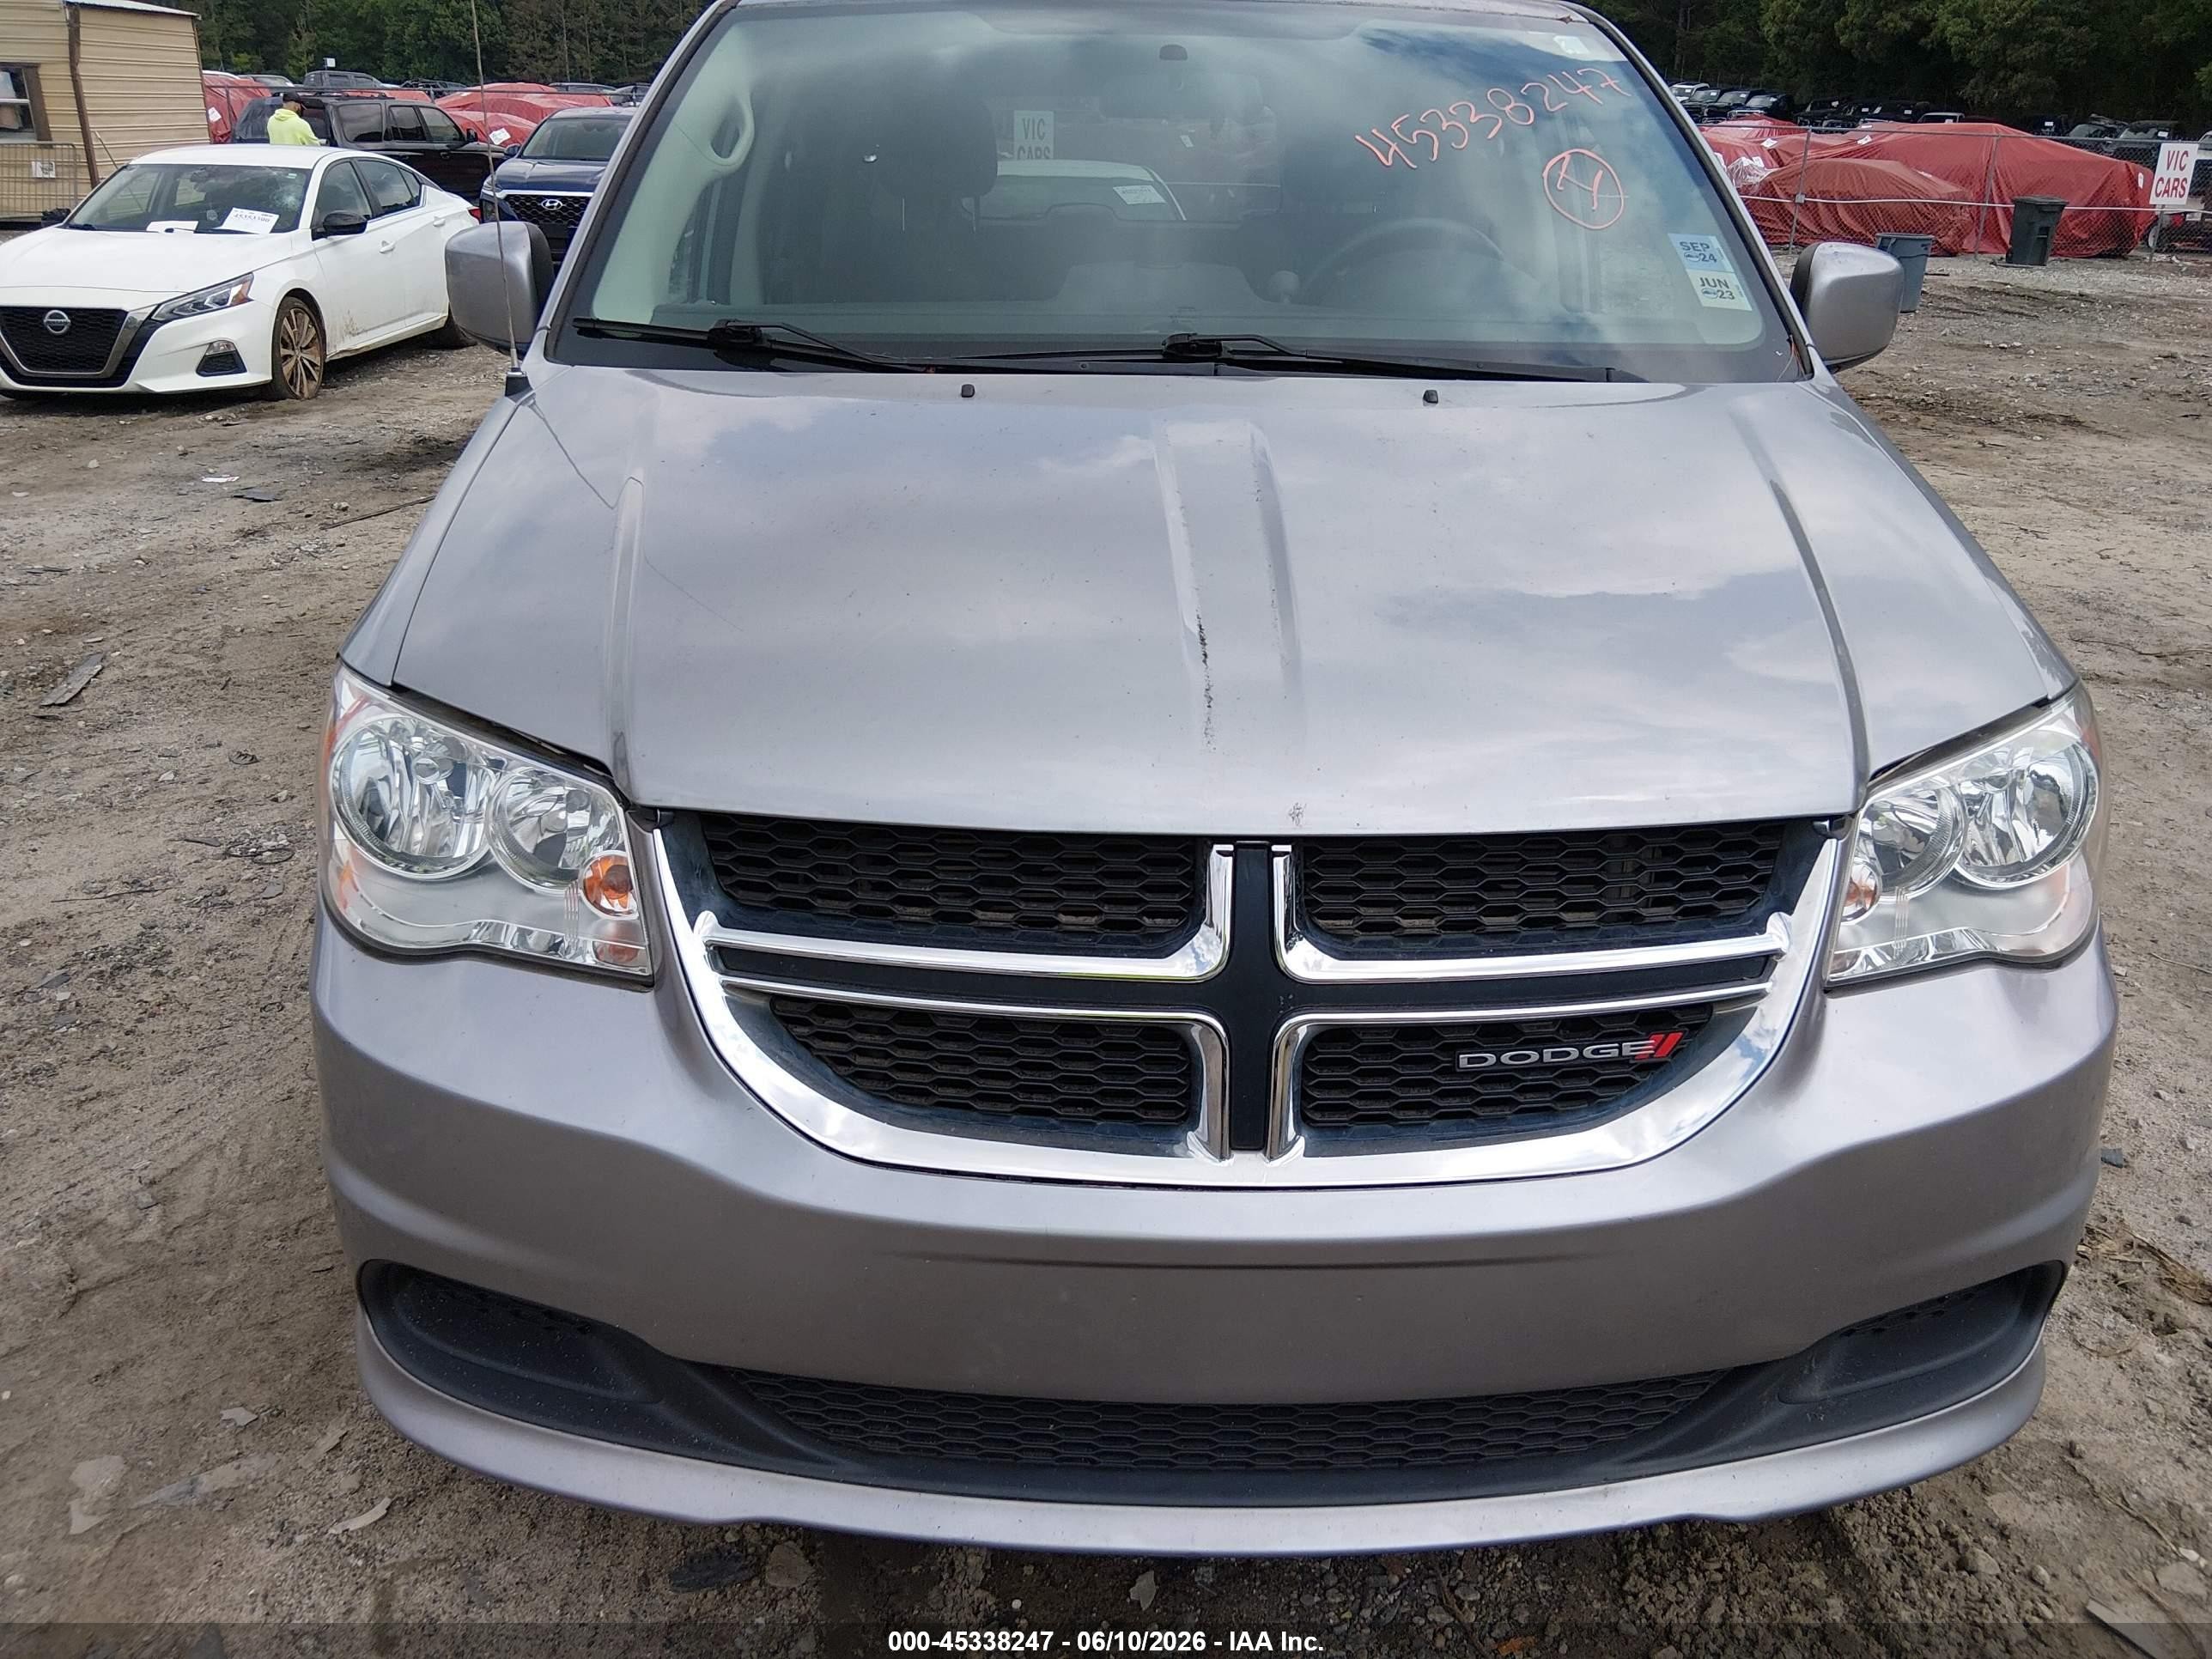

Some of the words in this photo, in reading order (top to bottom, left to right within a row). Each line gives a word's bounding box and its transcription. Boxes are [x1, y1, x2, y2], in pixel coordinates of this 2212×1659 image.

[1354, 68, 1632, 169] 45338247
[1022, 118, 1045, 141] VIC
[2166, 150, 2190, 172] VIC
[2154, 177, 2188, 198] CARS
[1680, 241, 1710, 252] SEP
[1698, 252, 1717, 263] 24
[1699, 277, 1730, 289] JUN
[1717, 290, 1735, 300] 23
[1459, 1040, 1656, 1068] DODGE
